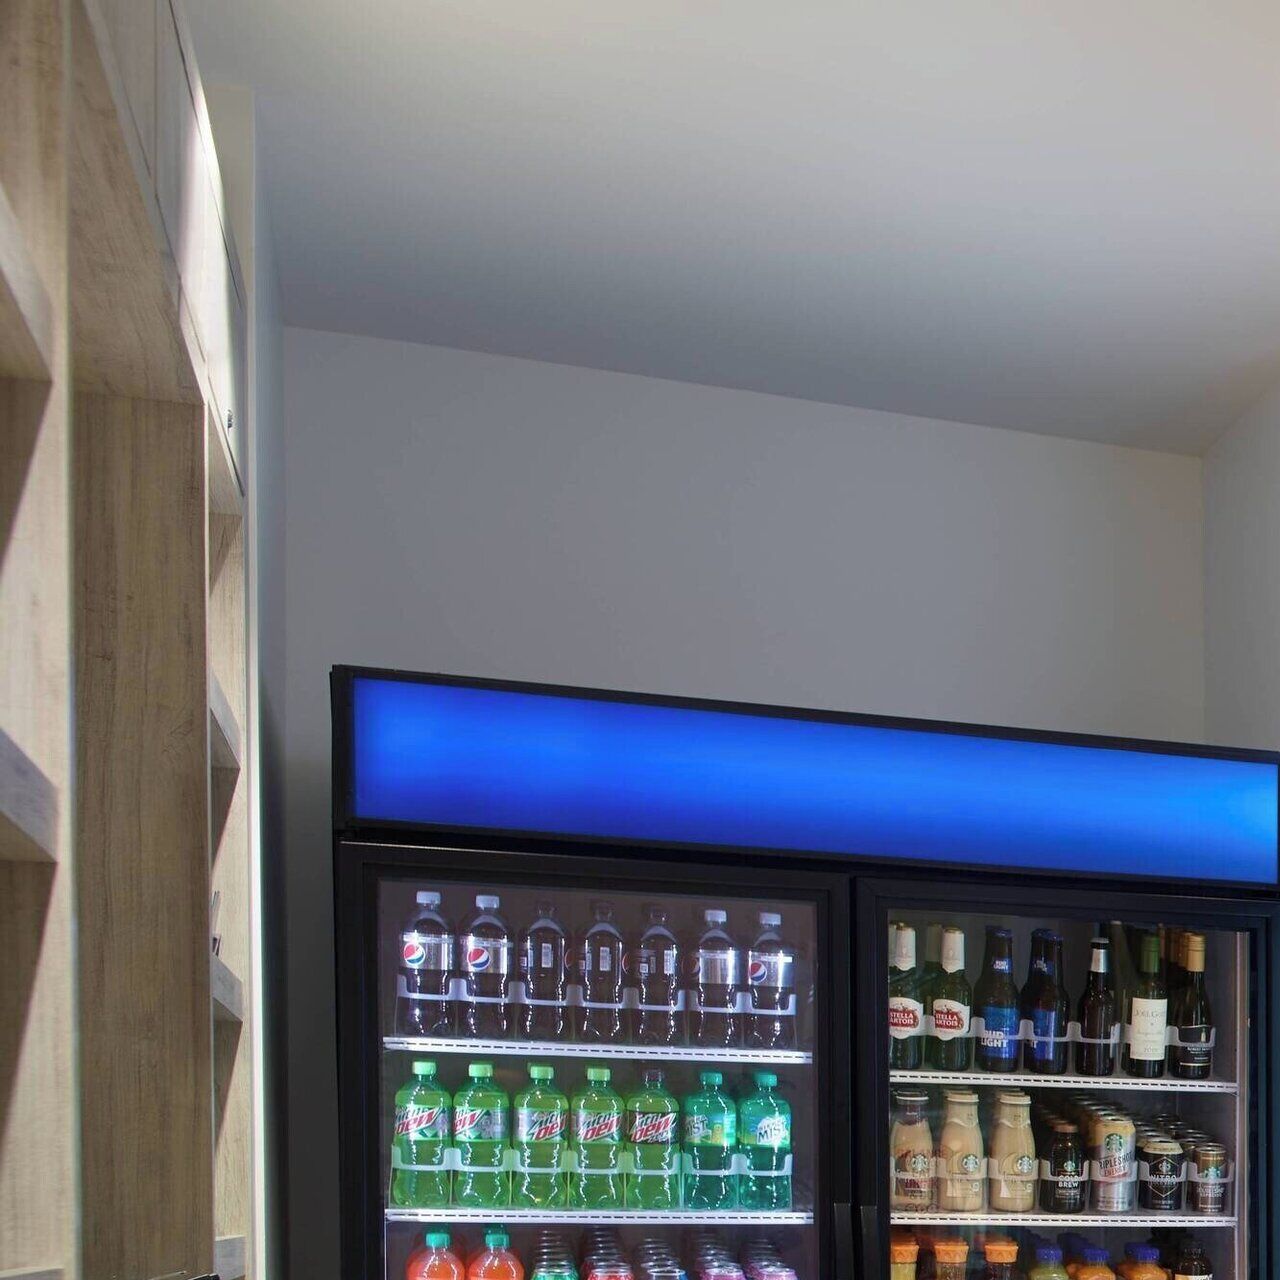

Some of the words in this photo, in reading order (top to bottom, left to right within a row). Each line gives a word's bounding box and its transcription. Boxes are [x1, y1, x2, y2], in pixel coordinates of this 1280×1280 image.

[936, 1012, 958, 1020] STELLA
[981, 1039, 1008, 1048] LIGHT
[1100, 1151, 1134, 1169] RIPLESHOT
